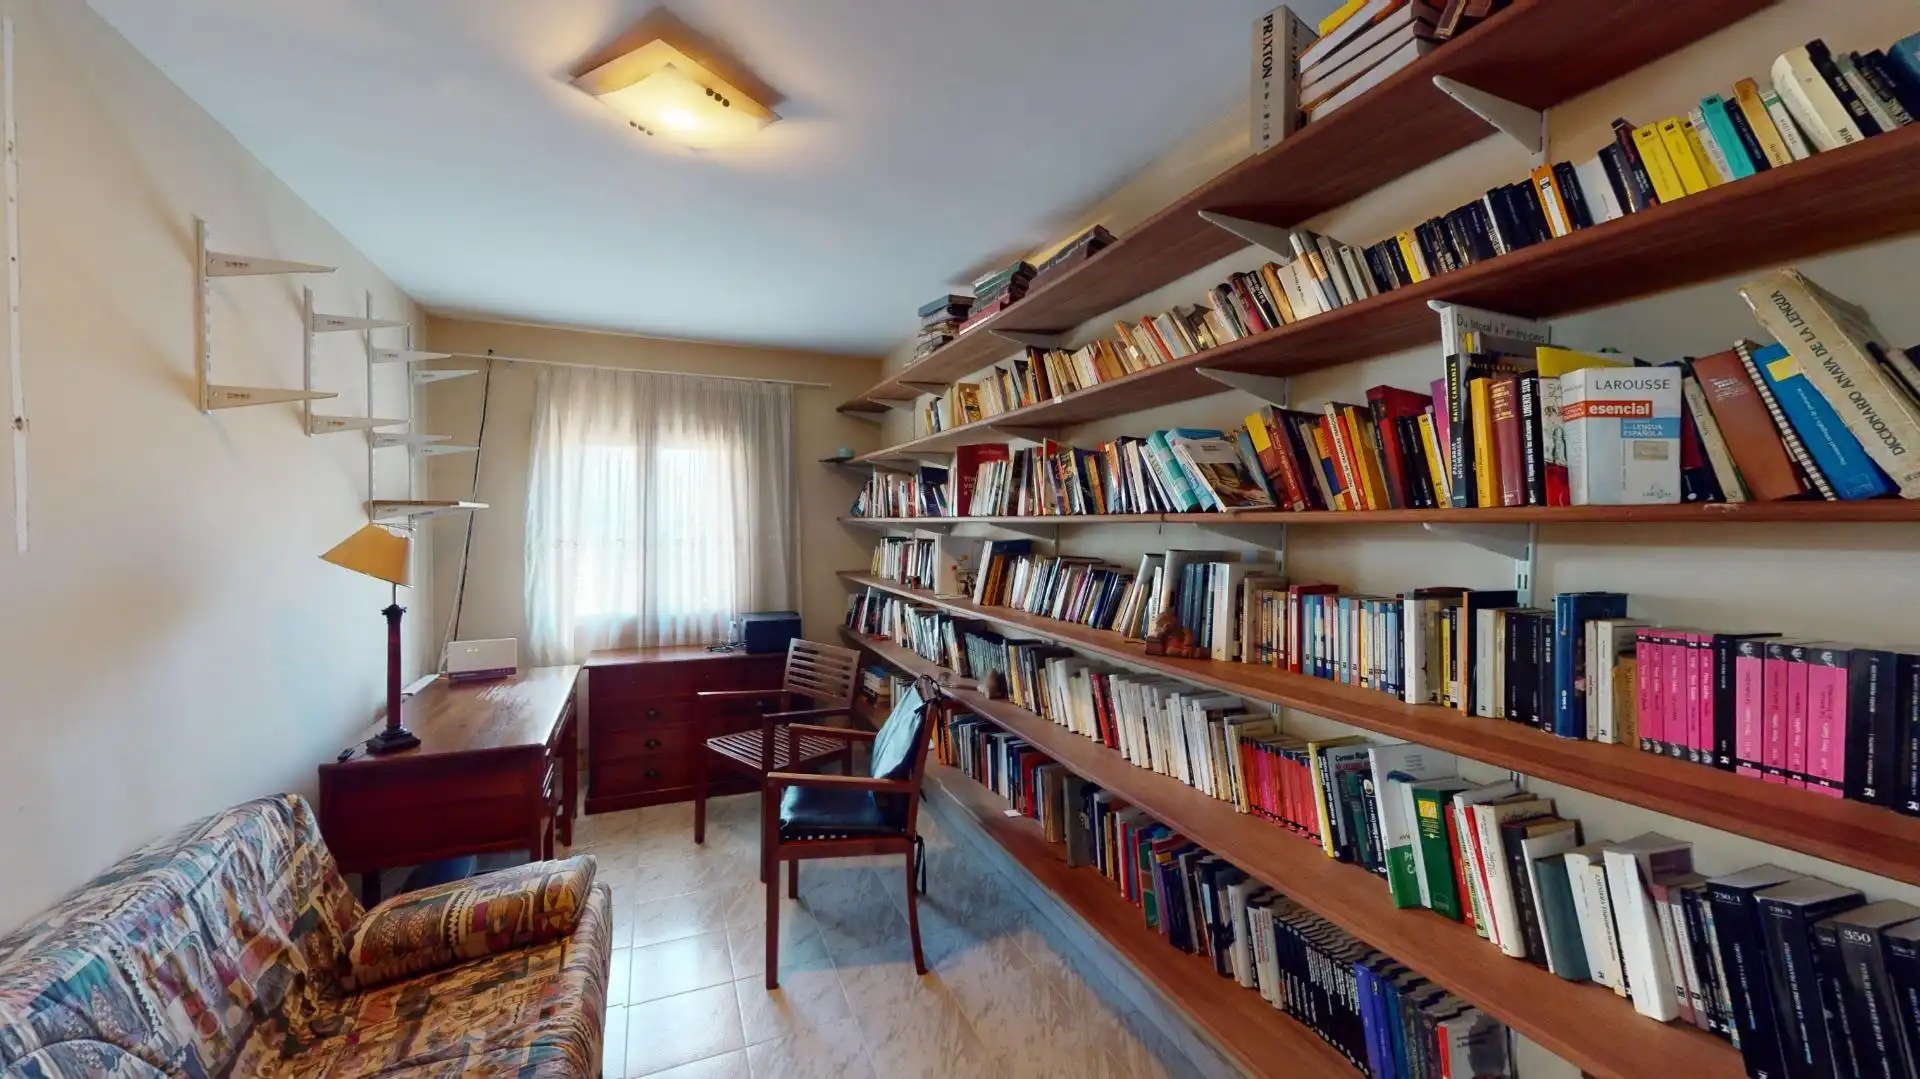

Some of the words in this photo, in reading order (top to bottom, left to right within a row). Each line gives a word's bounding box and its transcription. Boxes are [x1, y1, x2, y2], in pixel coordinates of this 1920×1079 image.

[1262, 14, 1273, 79] PRIXTON
[1770, 290, 1805, 329] LENGUA
[1799, 327, 1816, 343] LA
[1809, 341, 1828, 359] DE
[1822, 356, 1855, 389] ANAYA
[1522, 378, 1531, 392] SILVA
[1595, 379, 1670, 390] LAROUSSE
[1523, 393, 1532, 416] LORENZO
[1589, 402, 1650, 415] esencial
[1848, 386, 1906, 456] DICCIONARIO
[1404, 852, 1414, 861] Pr
